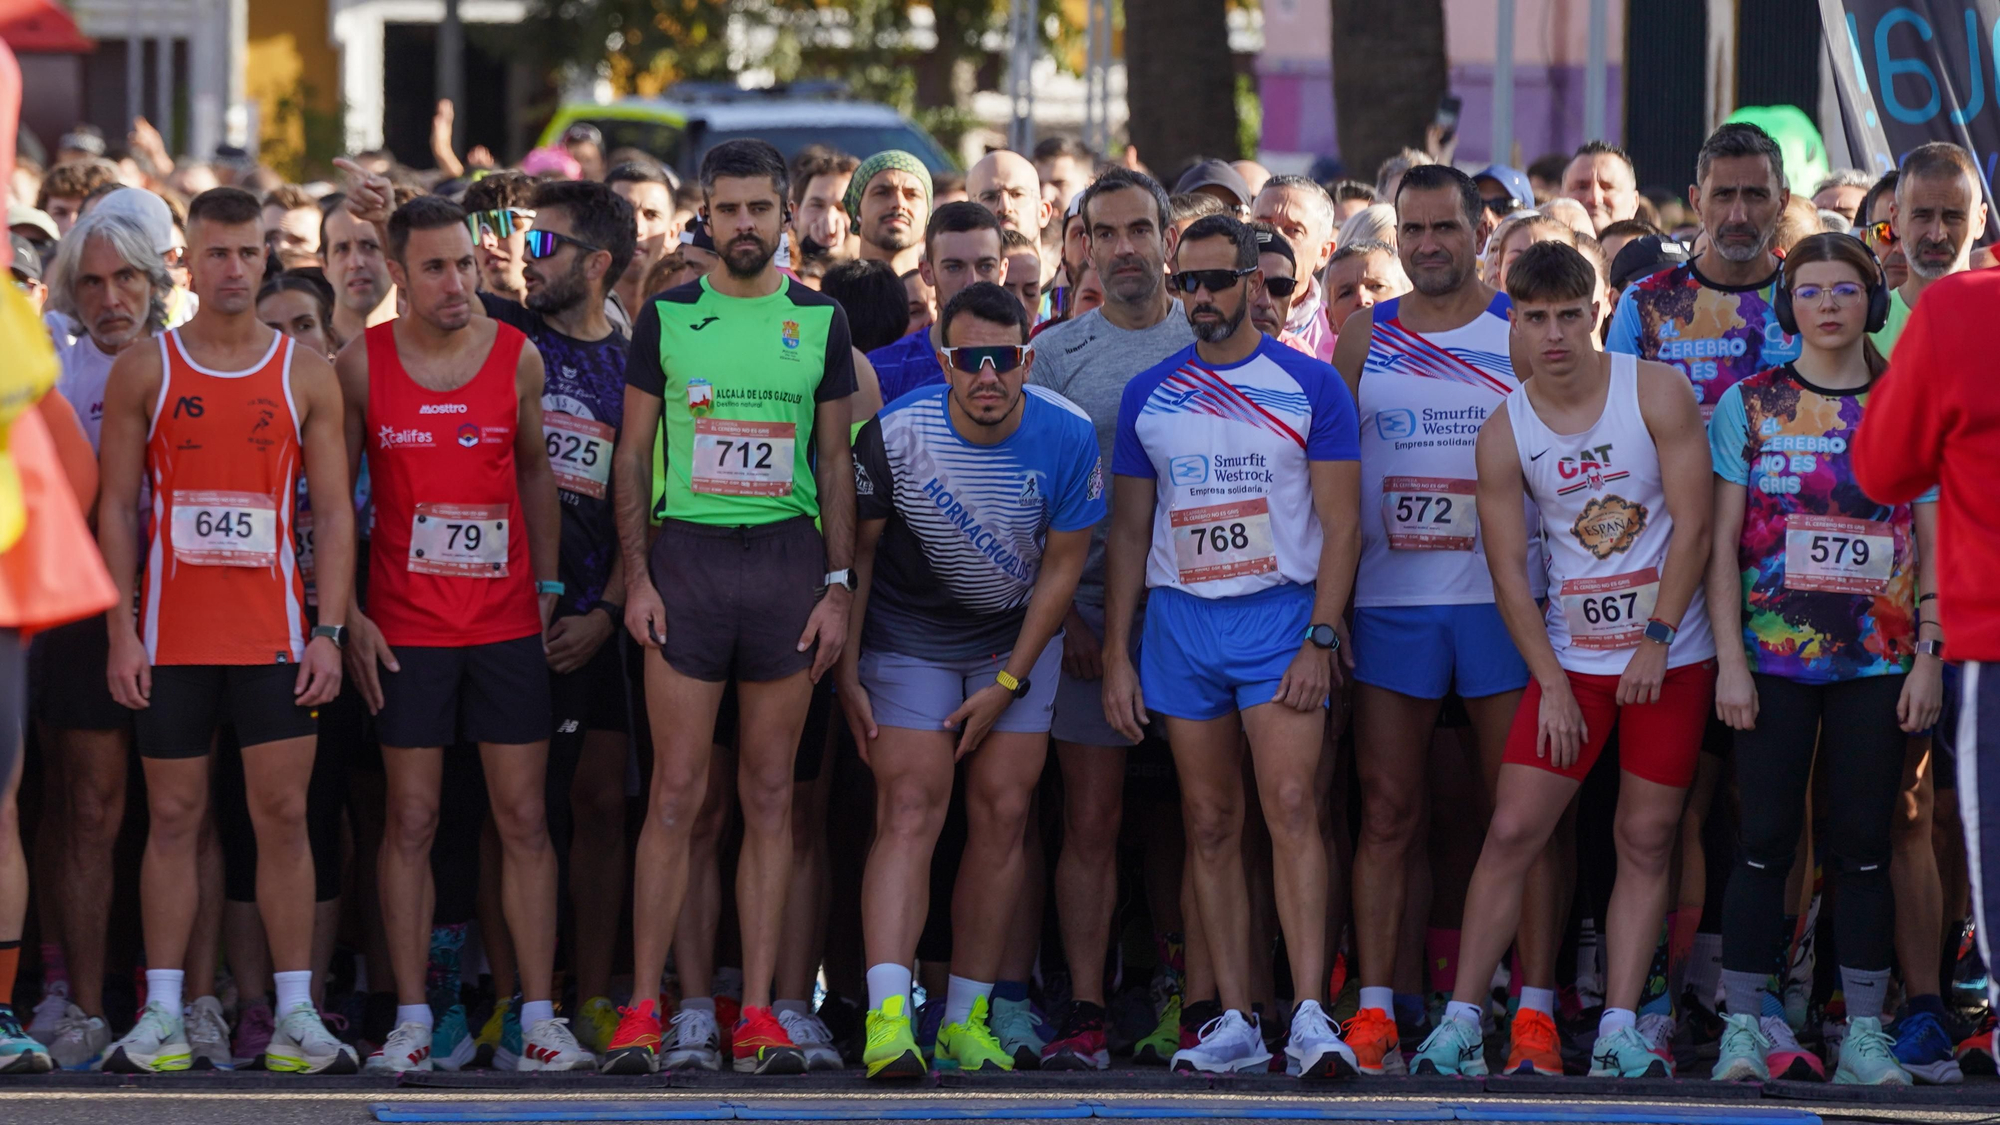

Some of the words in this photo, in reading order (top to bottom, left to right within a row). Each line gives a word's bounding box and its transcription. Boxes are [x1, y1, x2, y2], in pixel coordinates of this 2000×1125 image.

[1658, 338, 1747, 359] CEREBRO
[1691, 361, 1718, 380] ES
[716, 388, 745, 399] ALCALÁ
[747, 389, 757, 399] DE
[759, 390, 772, 400] LOS
[1422, 406, 1486, 421] Smurfit
[389, 429, 432, 443] califas
[1394, 441, 1434, 450] Empresa
[1437, 438, 1475, 447] solidari
[546, 432, 600, 467] 625
[716, 441, 773, 469] 712
[1214, 453, 1266, 467] Smurfit
[1558, 444, 1613, 479] CAT
[1760, 455, 1785, 472] NO
[1789, 455, 1817, 472] ES
[1214, 469, 1274, 483] Westrock
[1759, 476, 1801, 494] GRIS
[1190, 487, 1225, 496] Empresa
[1228, 485, 1262, 494] solidaria
[1396, 496, 1453, 524] 572
[195, 511, 253, 538] 645
[922, 478, 1031, 582] HORNACHUELOS
[1583, 516, 1634, 537] ESPAÑA
[446, 524, 481, 550] 79
[1191, 522, 1249, 555] 768
[1810, 536, 1869, 566] 579
[1583, 592, 1638, 625] 667
